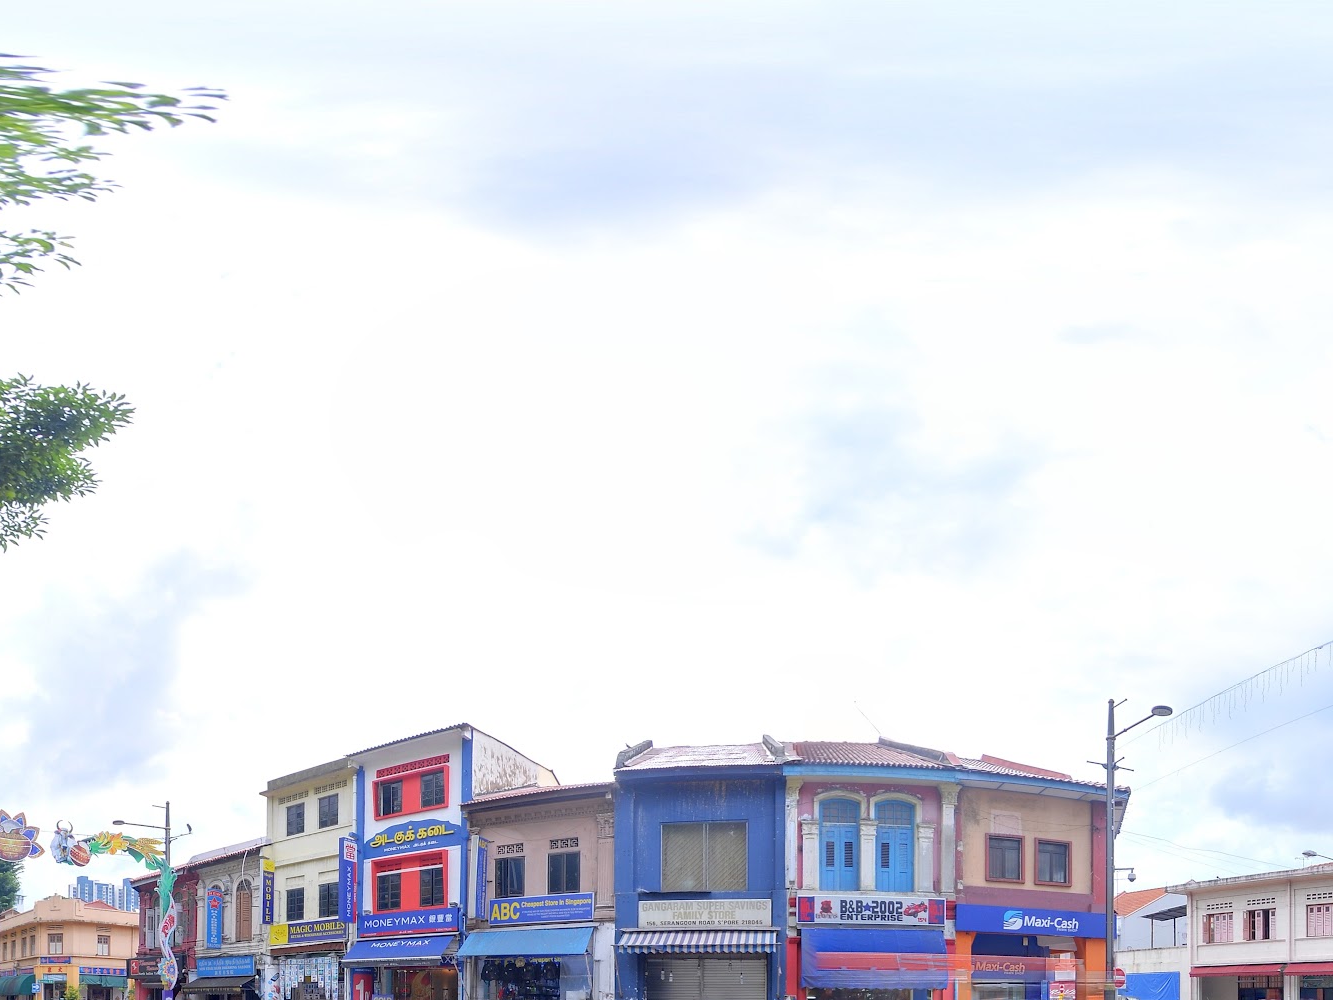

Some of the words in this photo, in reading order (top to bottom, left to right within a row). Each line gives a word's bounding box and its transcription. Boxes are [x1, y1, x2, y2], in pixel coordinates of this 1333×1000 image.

[491, 901, 520, 921] ABC
[642, 902, 693, 912] GANGARAM
[696, 901, 725, 911] SUPER
[728, 901, 768, 911] SAVINGS
[871, 901, 903, 915] 2002
[672, 911, 704, 920] FAMILY
[708, 911, 736, 919] STORE
[839, 914, 904, 922] ENTERPRISE
[290, 924, 313, 934] MAGIC
[313, 921, 345, 932] MOBILES
[364, 915, 425, 929] MONEYMAX
[1024, 915, 1079, 930] Maxi-Cash
[370, 939, 431, 948] MONEYMAX
[975, 961, 1026, 973] Maxi-Cash
